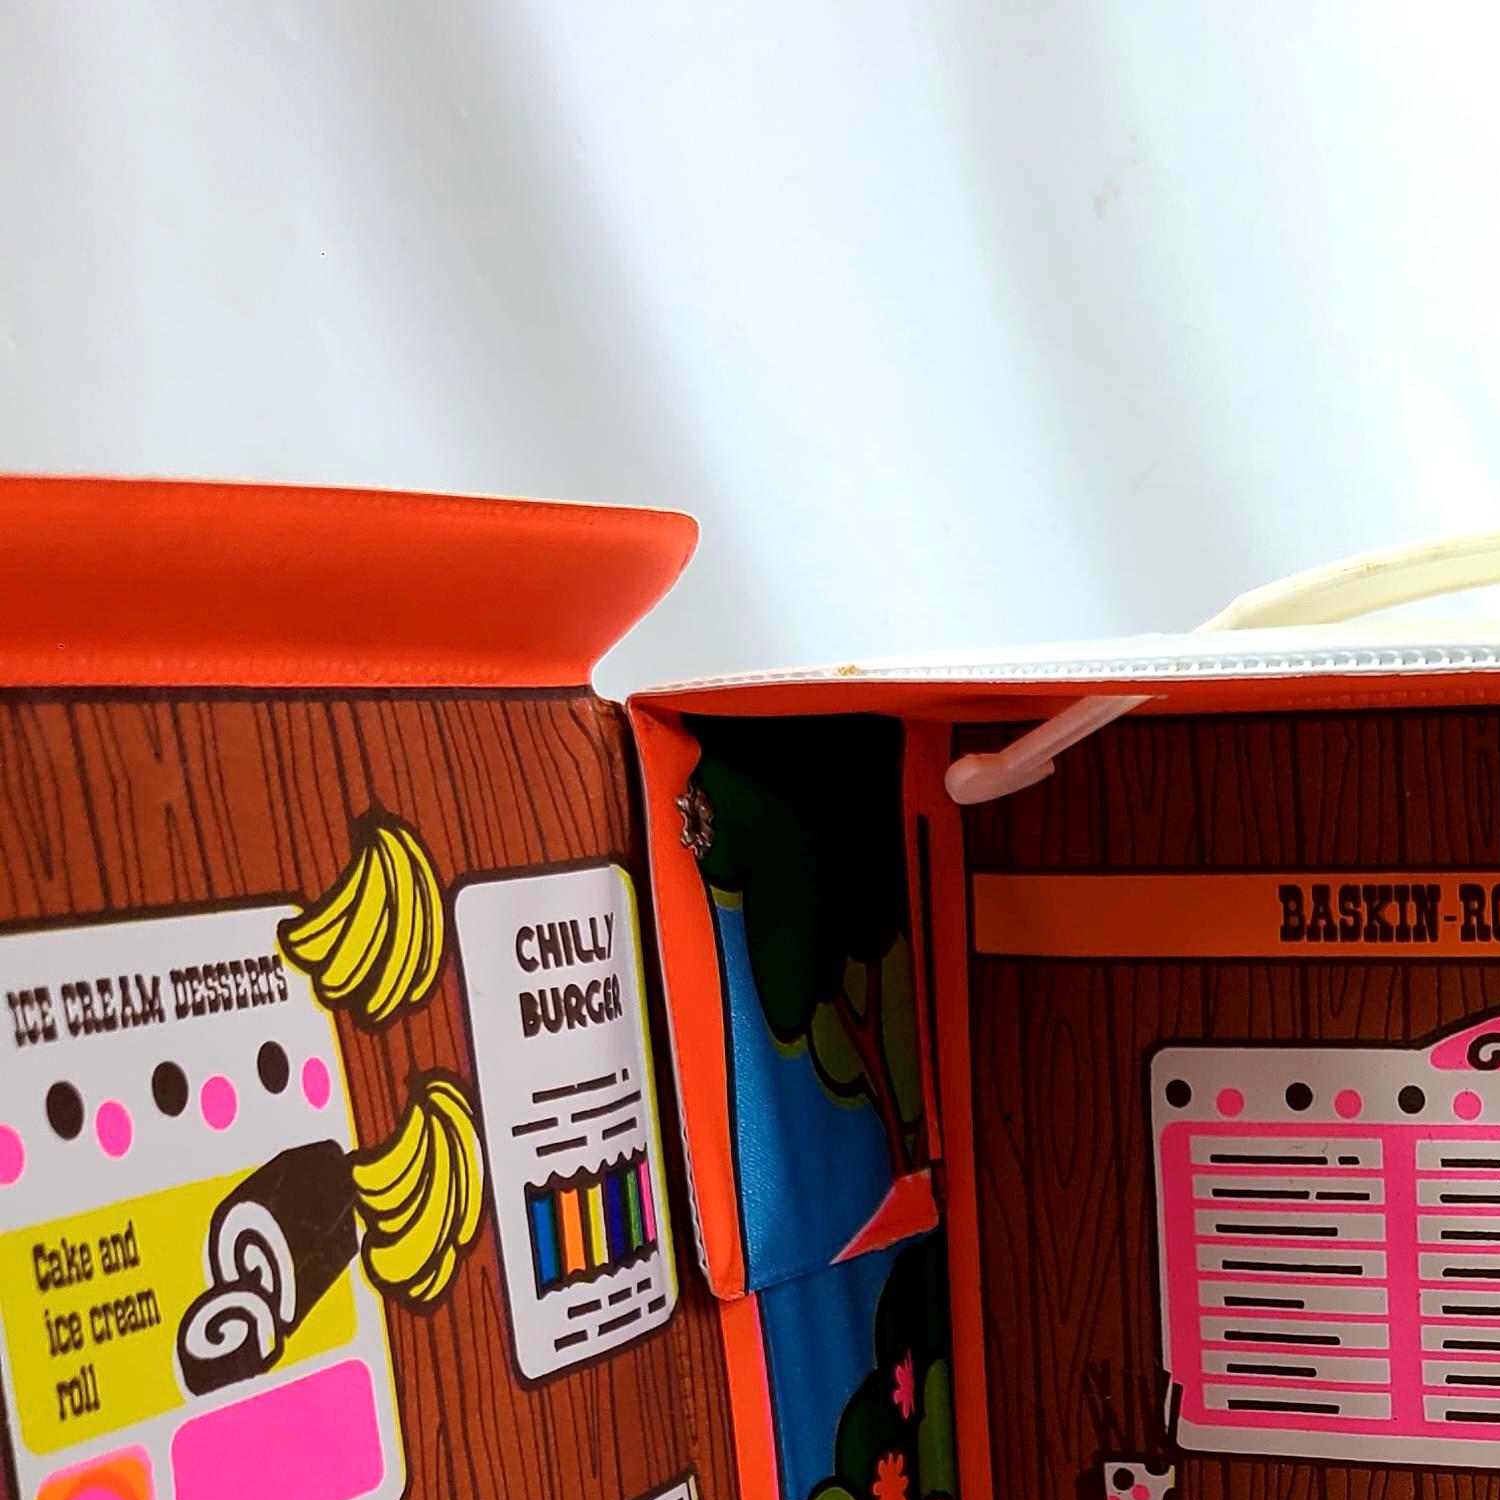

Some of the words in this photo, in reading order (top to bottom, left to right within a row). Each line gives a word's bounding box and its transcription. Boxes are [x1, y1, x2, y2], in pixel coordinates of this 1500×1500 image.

[515, 912, 613, 973] CHILLY
[8, 987, 58, 1048] ICE
[61, 974, 166, 1038] CREAM
[169, 955, 289, 1020] DESSERTS
[519, 973, 622, 1038] BURGER
[32, 1237, 94, 1292] Cake
[98, 1219, 140, 1275] and
[45, 1309, 84, 1357] ice
[89, 1288, 161, 1345] cream
[56, 1363, 100, 1421] roll
